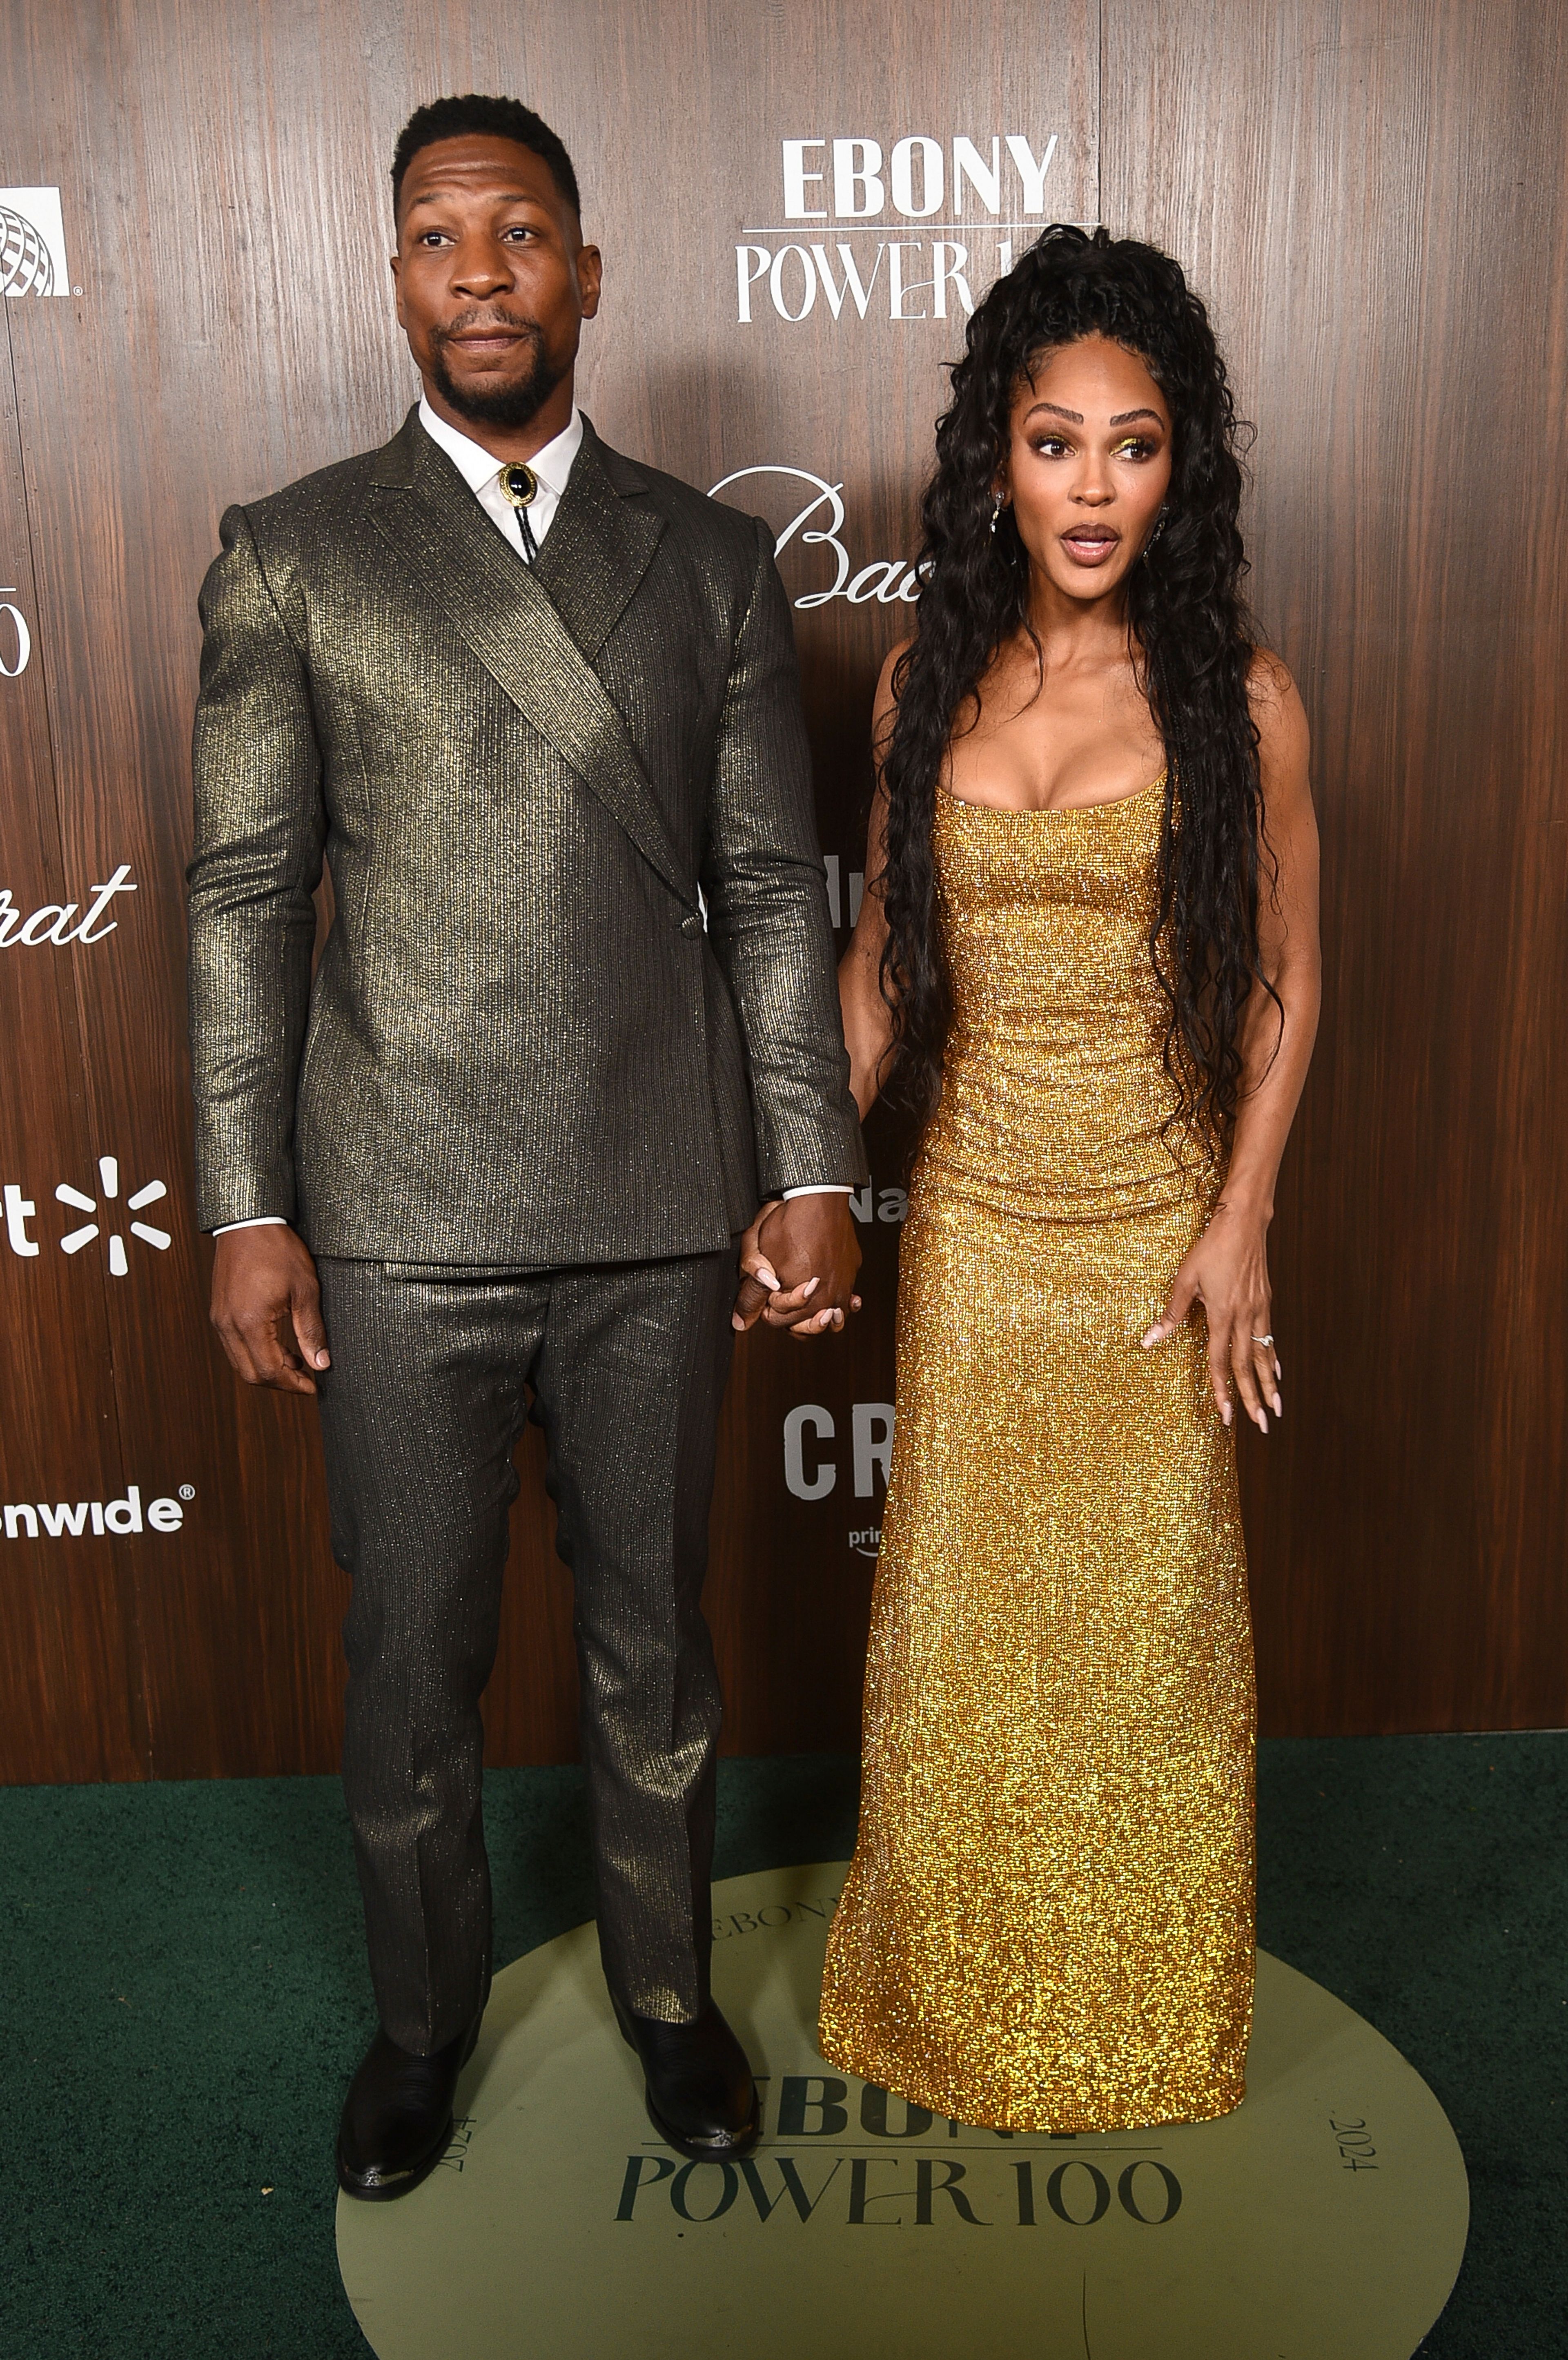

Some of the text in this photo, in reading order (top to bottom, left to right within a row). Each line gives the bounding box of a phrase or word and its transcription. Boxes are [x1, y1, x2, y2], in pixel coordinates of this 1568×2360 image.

[782, 135, 1058, 219] EBONY
[735, 242, 975, 323] POWER
[0, 1185, 40, 1257] t
[784, 1403, 895, 1500] CR
[1329, 2118, 1379, 2172] 2024
[612, 2155, 1183, 2226] POWER 100
